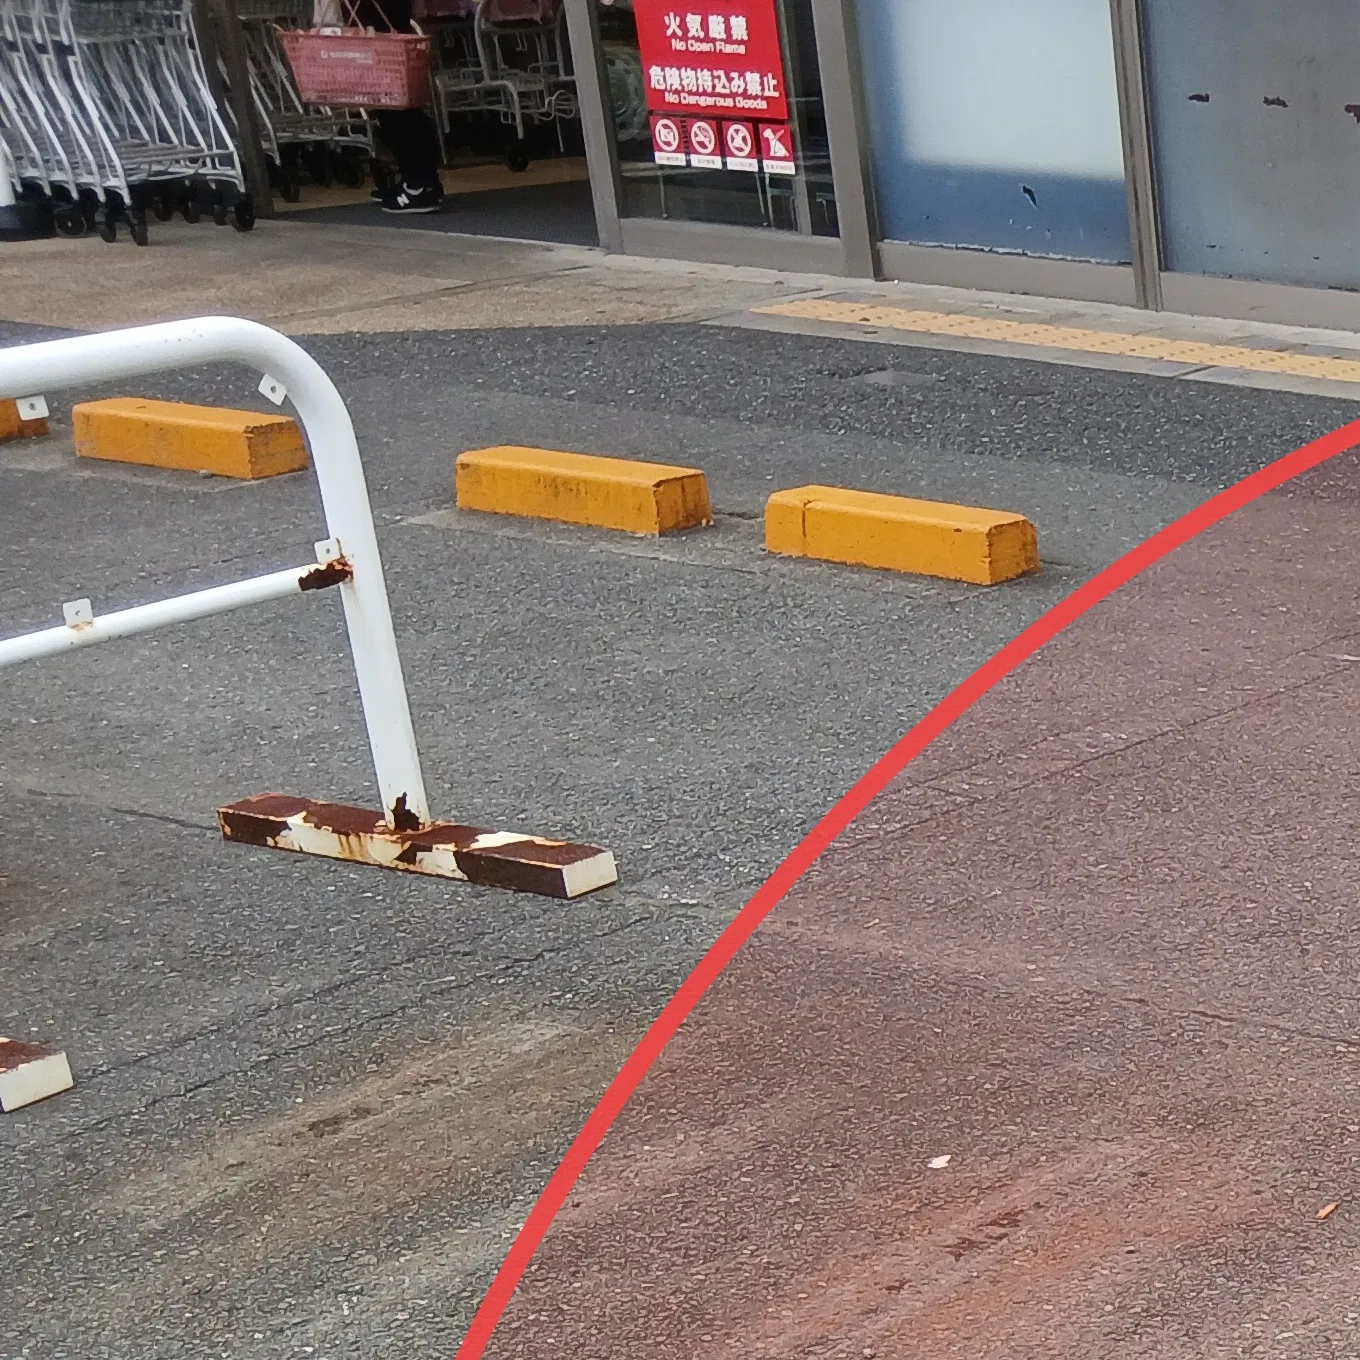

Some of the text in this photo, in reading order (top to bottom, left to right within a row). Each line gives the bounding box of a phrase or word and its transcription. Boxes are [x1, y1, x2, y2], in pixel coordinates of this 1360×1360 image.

[664, 12, 748, 40] 火気厳禁
[671, 39, 746, 54] No Open Flame
[649, 65, 779, 97] 危険物持込み禁止
[664, 91, 768, 109] No Dangerous Goods
